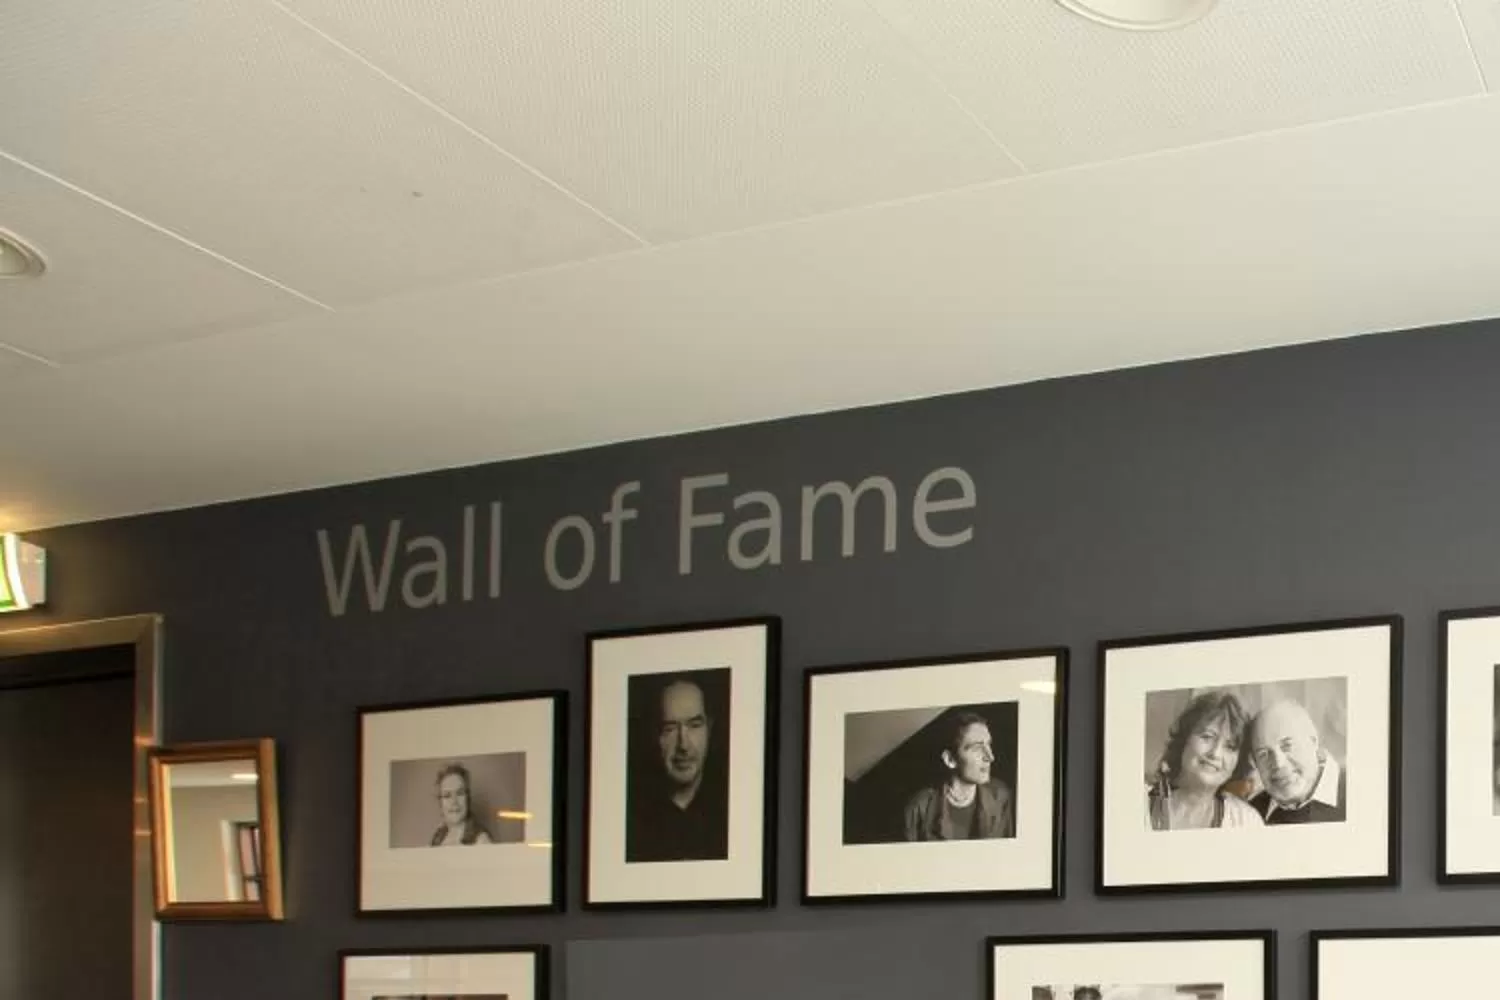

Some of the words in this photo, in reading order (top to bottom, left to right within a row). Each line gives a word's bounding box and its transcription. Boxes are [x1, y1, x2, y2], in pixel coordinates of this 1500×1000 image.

[316, 501, 503, 618] Wall
[543, 480, 641, 592] of
[678, 465, 977, 575] Fame
